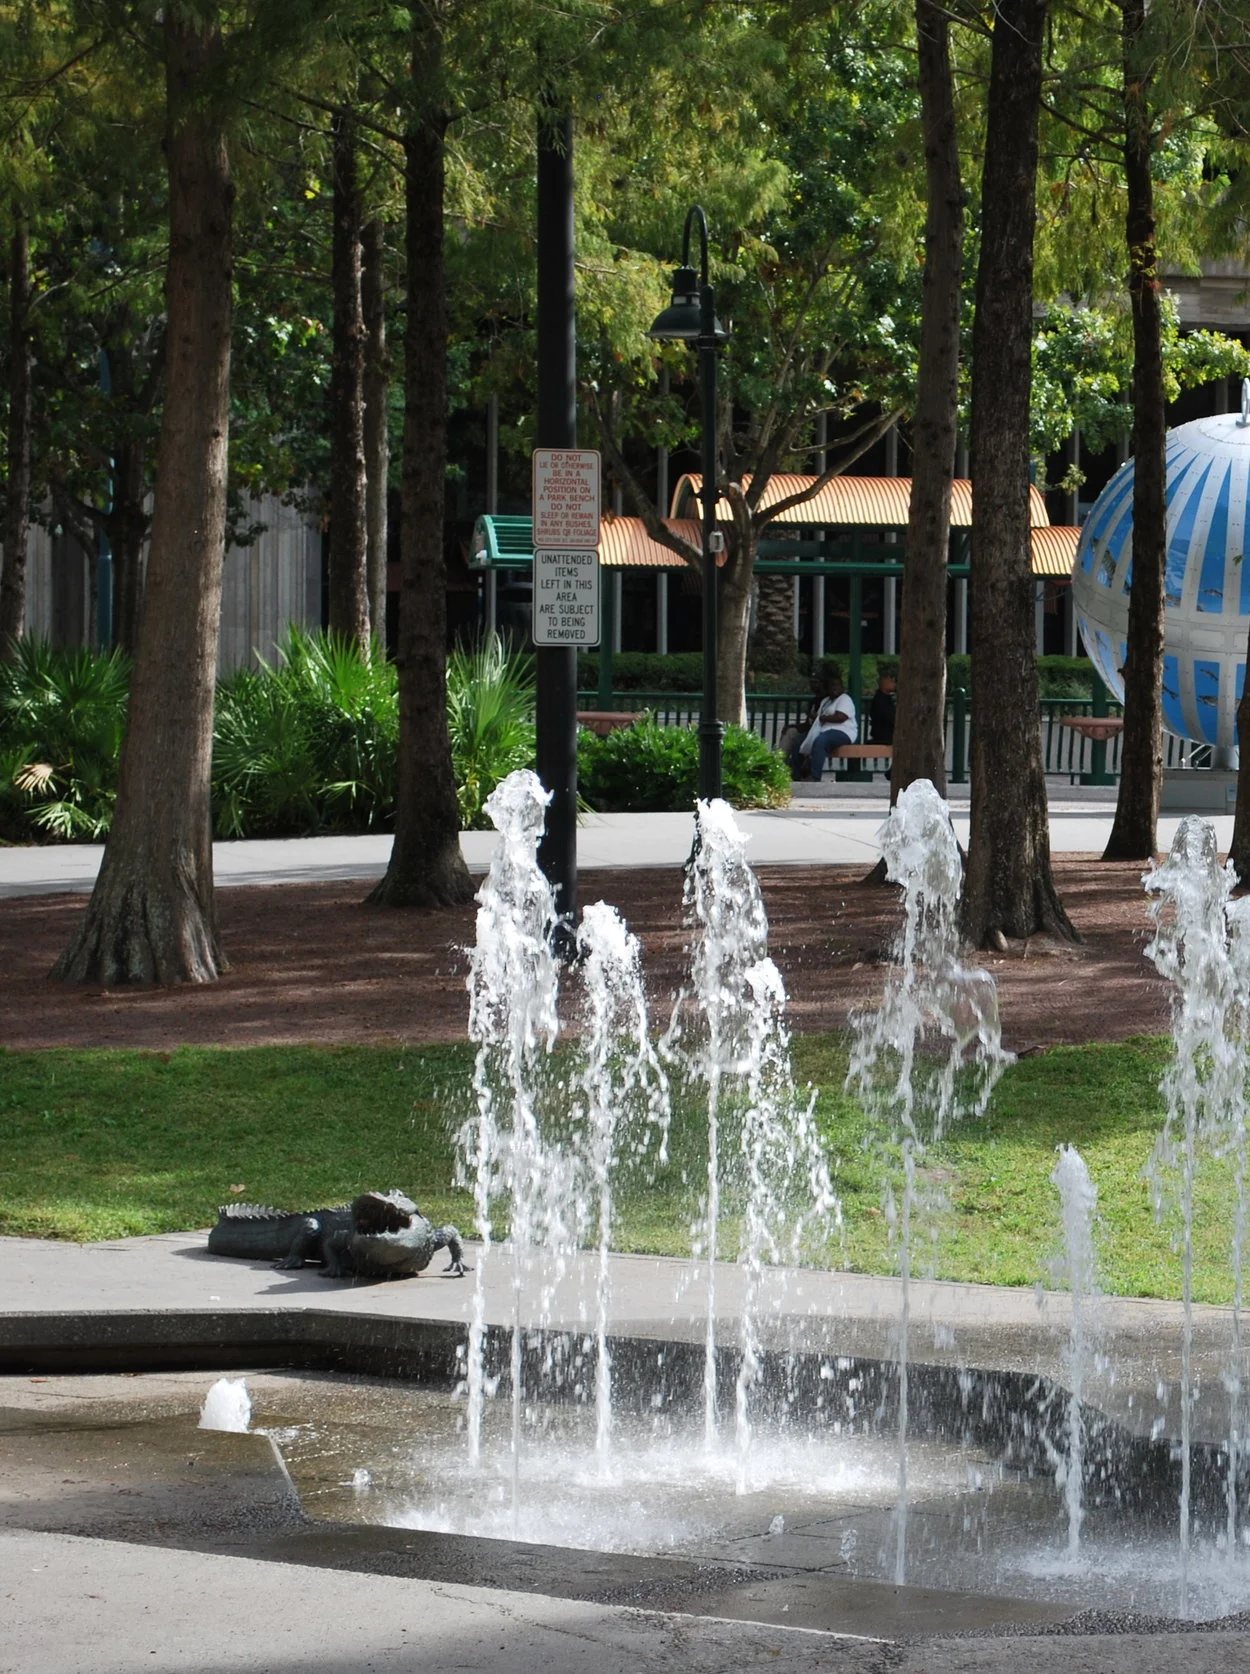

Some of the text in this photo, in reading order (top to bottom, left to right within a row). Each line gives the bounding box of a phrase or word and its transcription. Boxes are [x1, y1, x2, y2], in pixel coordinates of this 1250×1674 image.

[552, 453, 582, 462] DO NOT
[544, 478, 590, 486] HORIZONTAL
[544, 486, 577, 494] POSITION
[536, 528, 561, 536] SHRUBS
[541, 554, 593, 565] UNATTENDED
[555, 566, 579, 577] ITEMS
[540, 579, 593, 590] LEFT IN THIS
[556, 592, 578, 602] AREA
[539, 604, 594, 614] ARE SUBJECT
[548, 616, 586, 627] TO BEING
[547, 629, 586, 640] REMOVED
